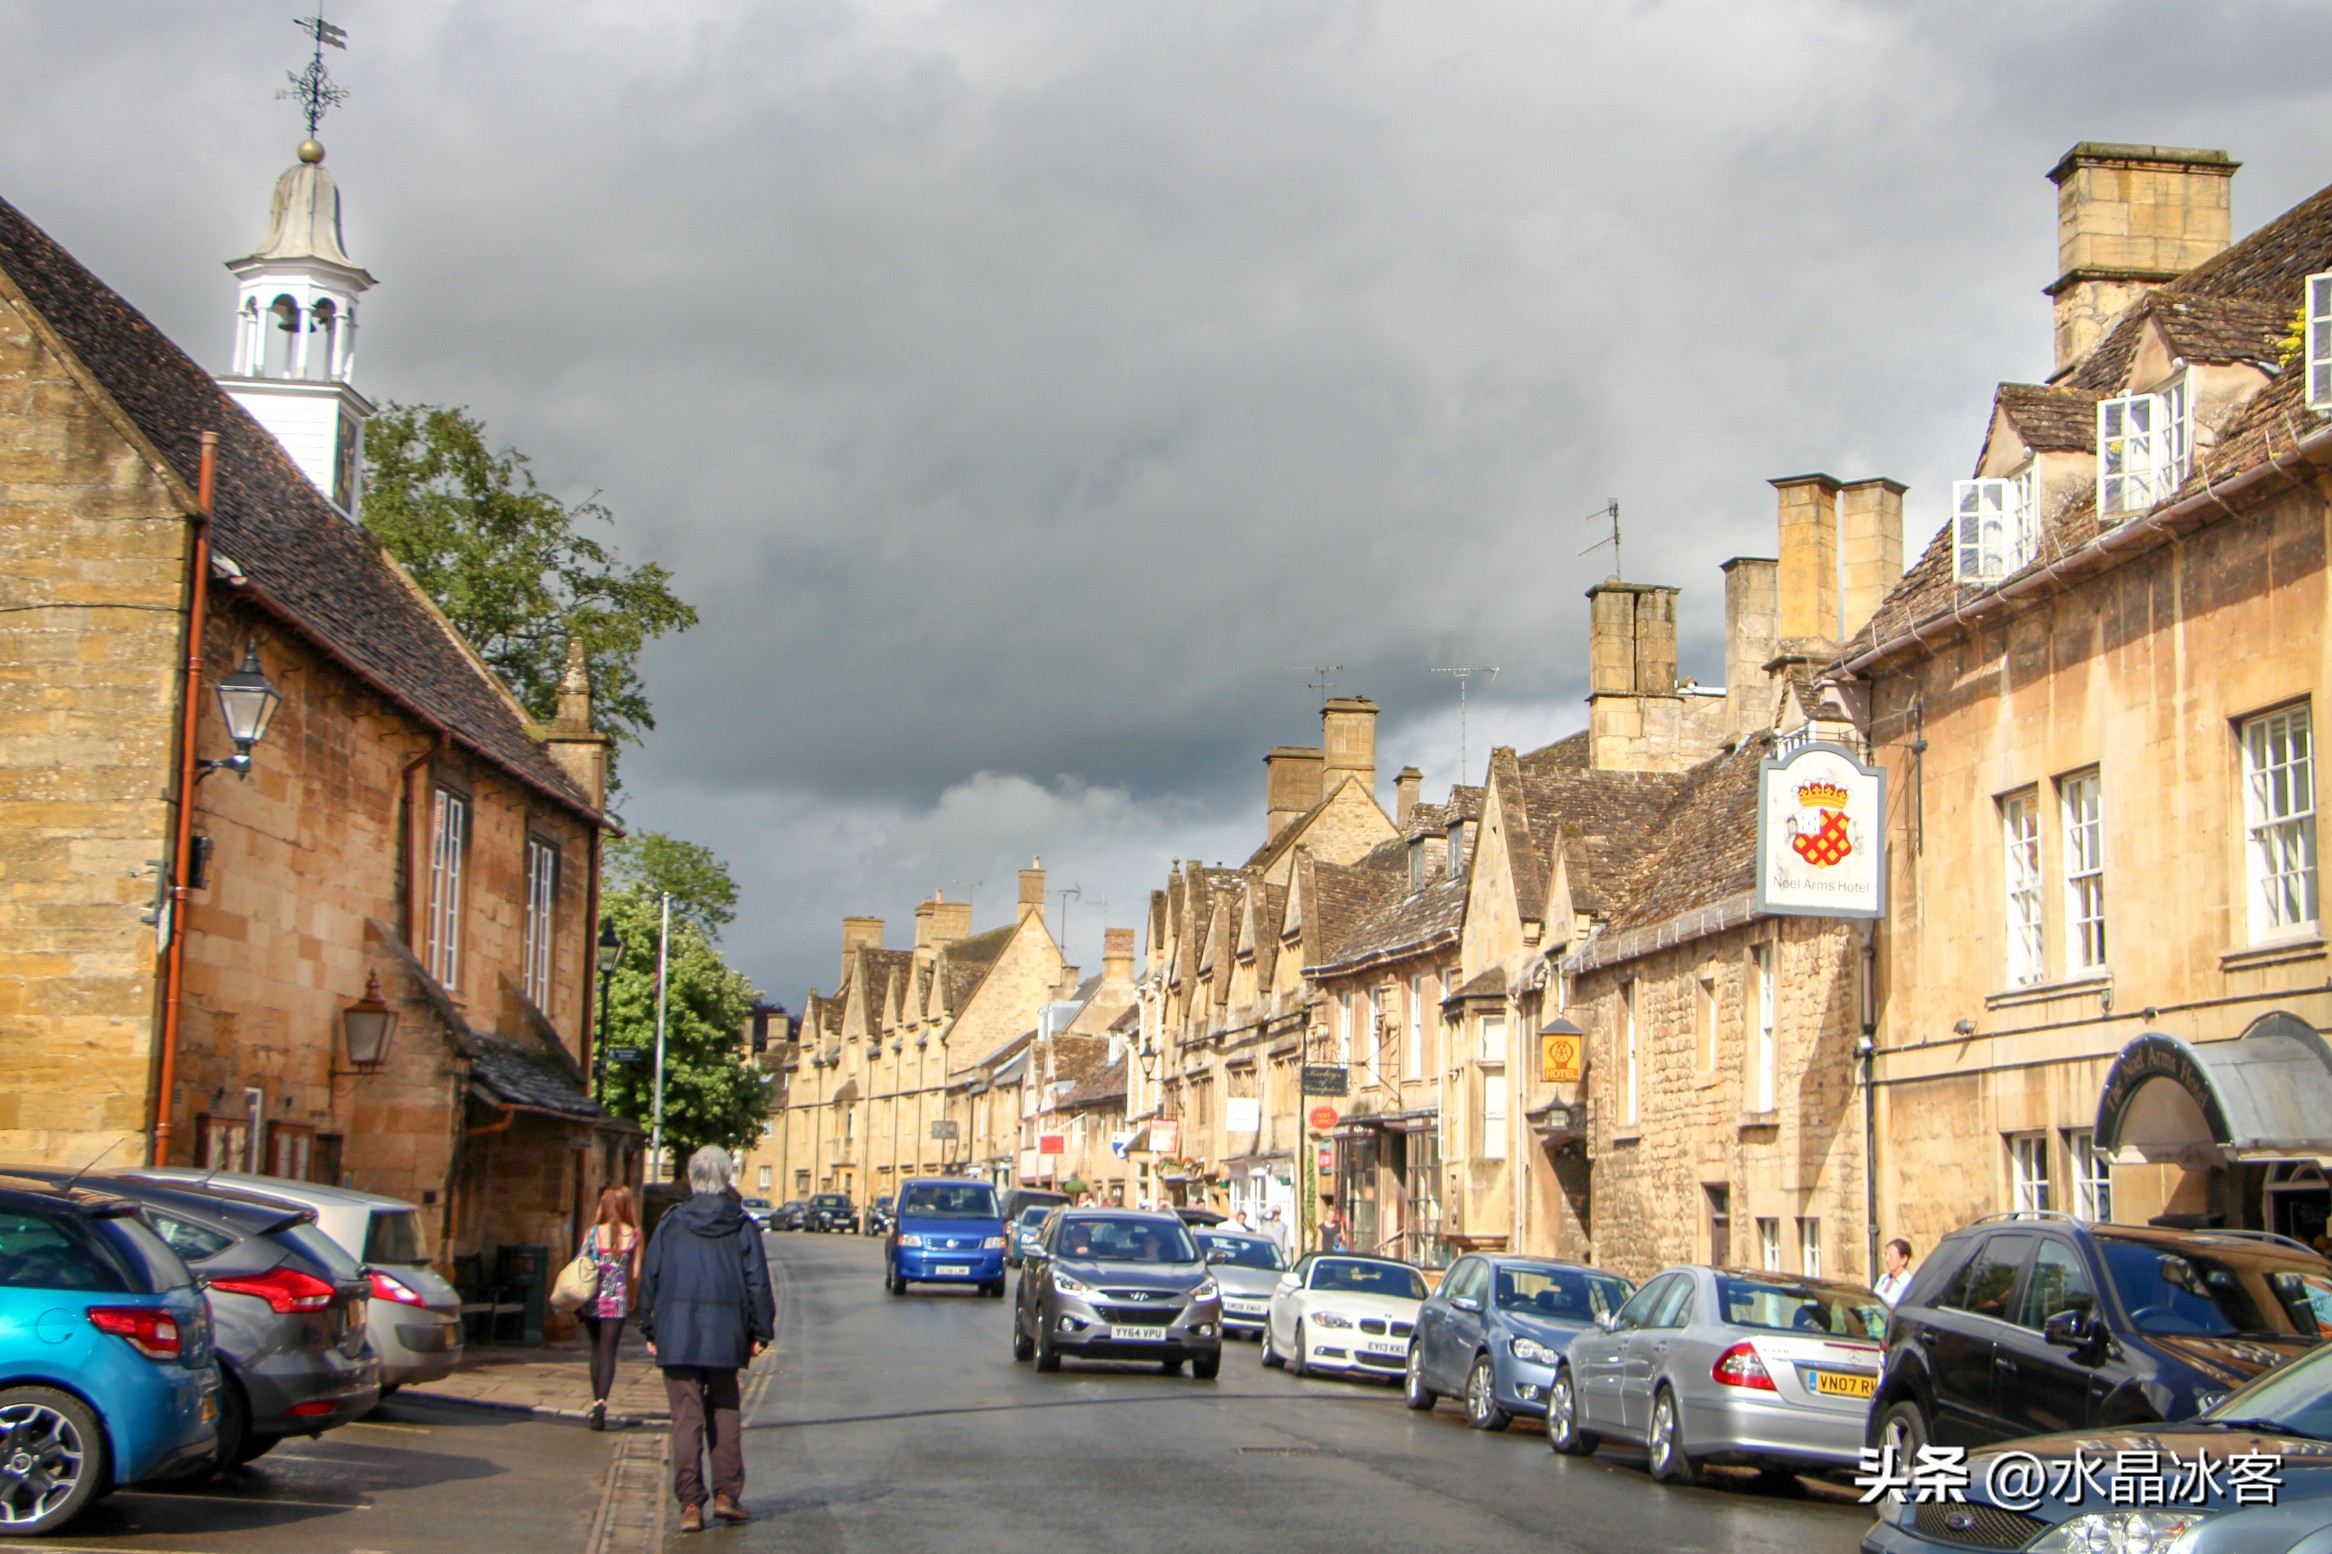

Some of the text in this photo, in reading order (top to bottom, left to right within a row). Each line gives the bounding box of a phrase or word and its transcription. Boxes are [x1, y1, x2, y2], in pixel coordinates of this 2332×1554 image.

[1773, 876, 1870, 893] Noel Arms Hotel
[1545, 1069, 1578, 1079] HOTEL
[2147, 1045, 2177, 1070] Arms
[2180, 1058, 2208, 1110] Hotel
[1115, 1327, 1162, 1338] YY64 VPU
[1368, 1341, 1388, 1352] EY13
[1820, 1374, 1857, 1392] VN07
